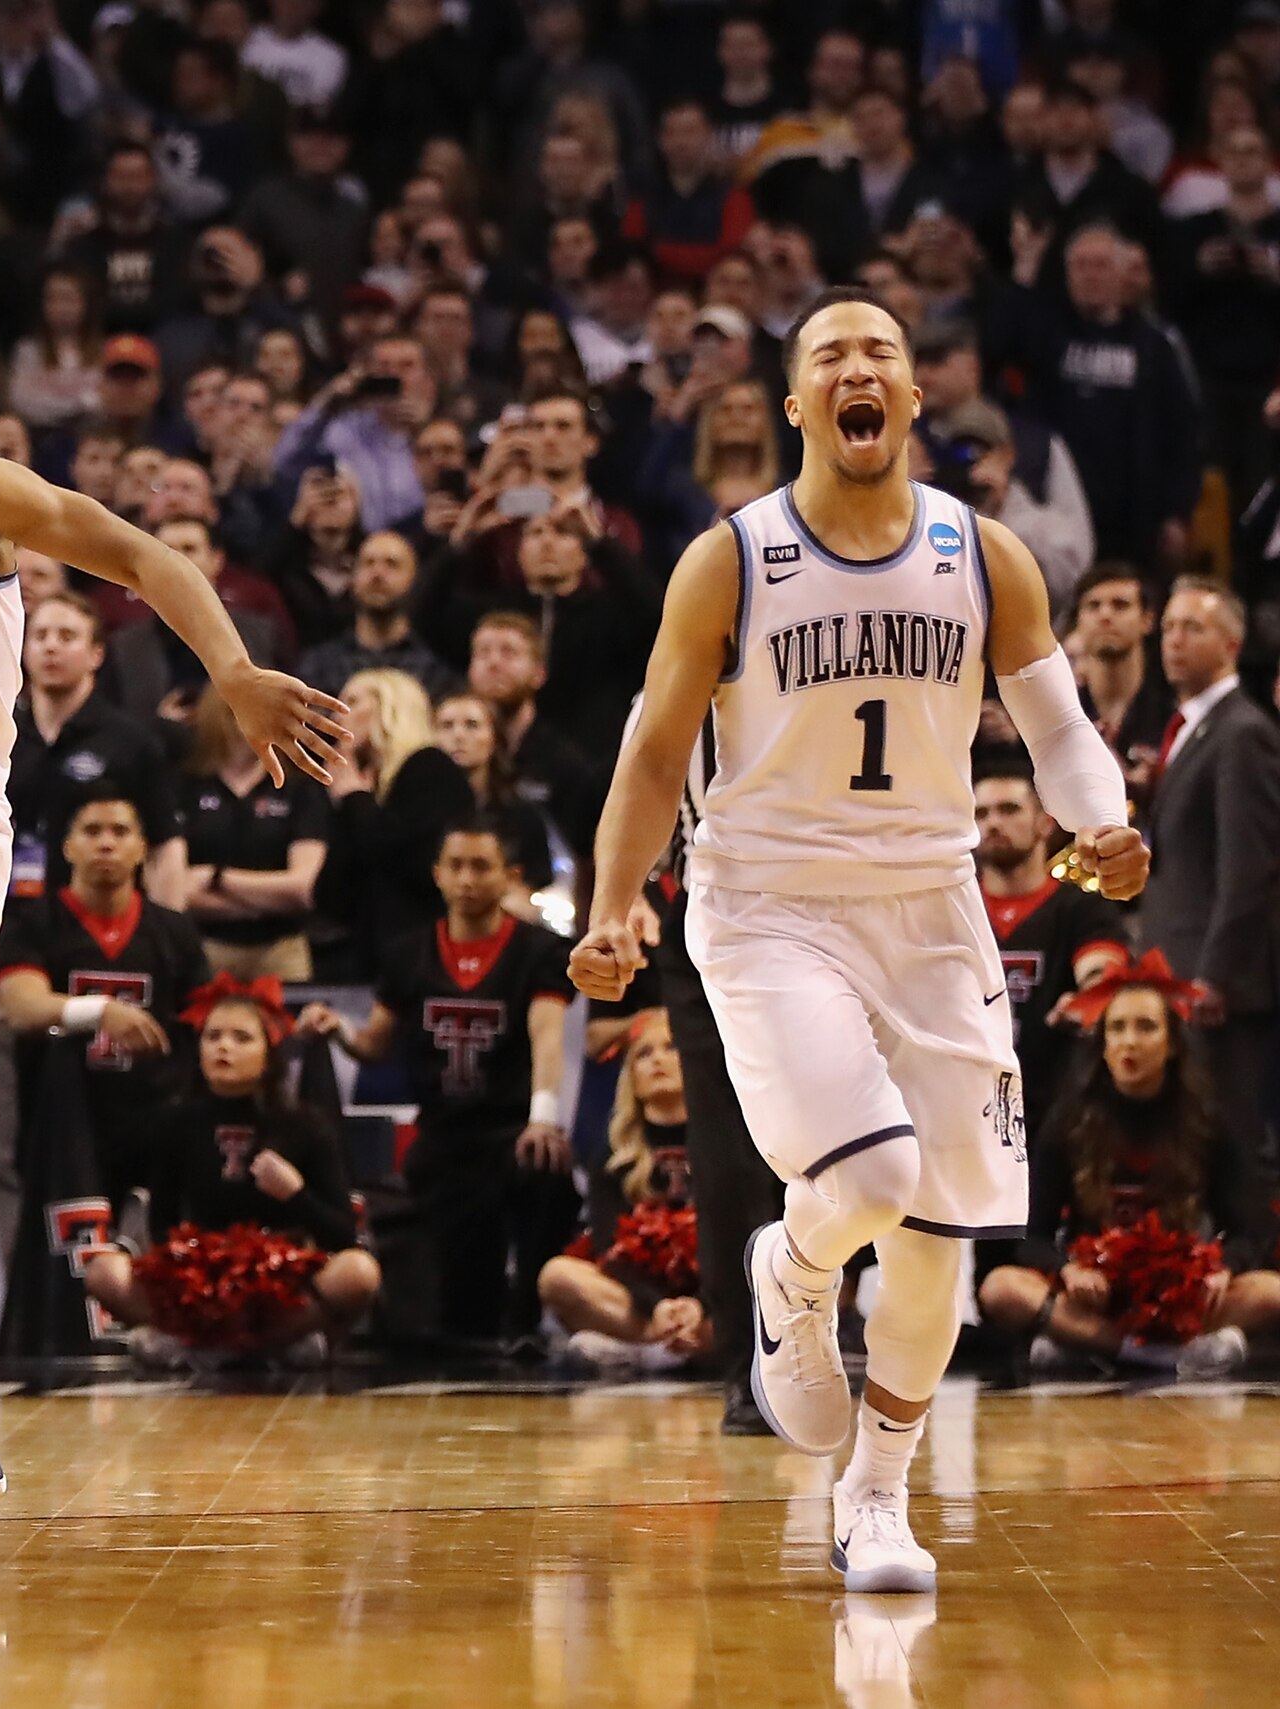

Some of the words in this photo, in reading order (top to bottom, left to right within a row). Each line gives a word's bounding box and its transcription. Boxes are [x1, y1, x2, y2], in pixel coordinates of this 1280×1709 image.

[768, 547, 796, 560] RVM
[933, 536, 962, 548] NCAA
[767, 610, 969, 696] VILLANOVA
[850, 699, 893, 790] 1
